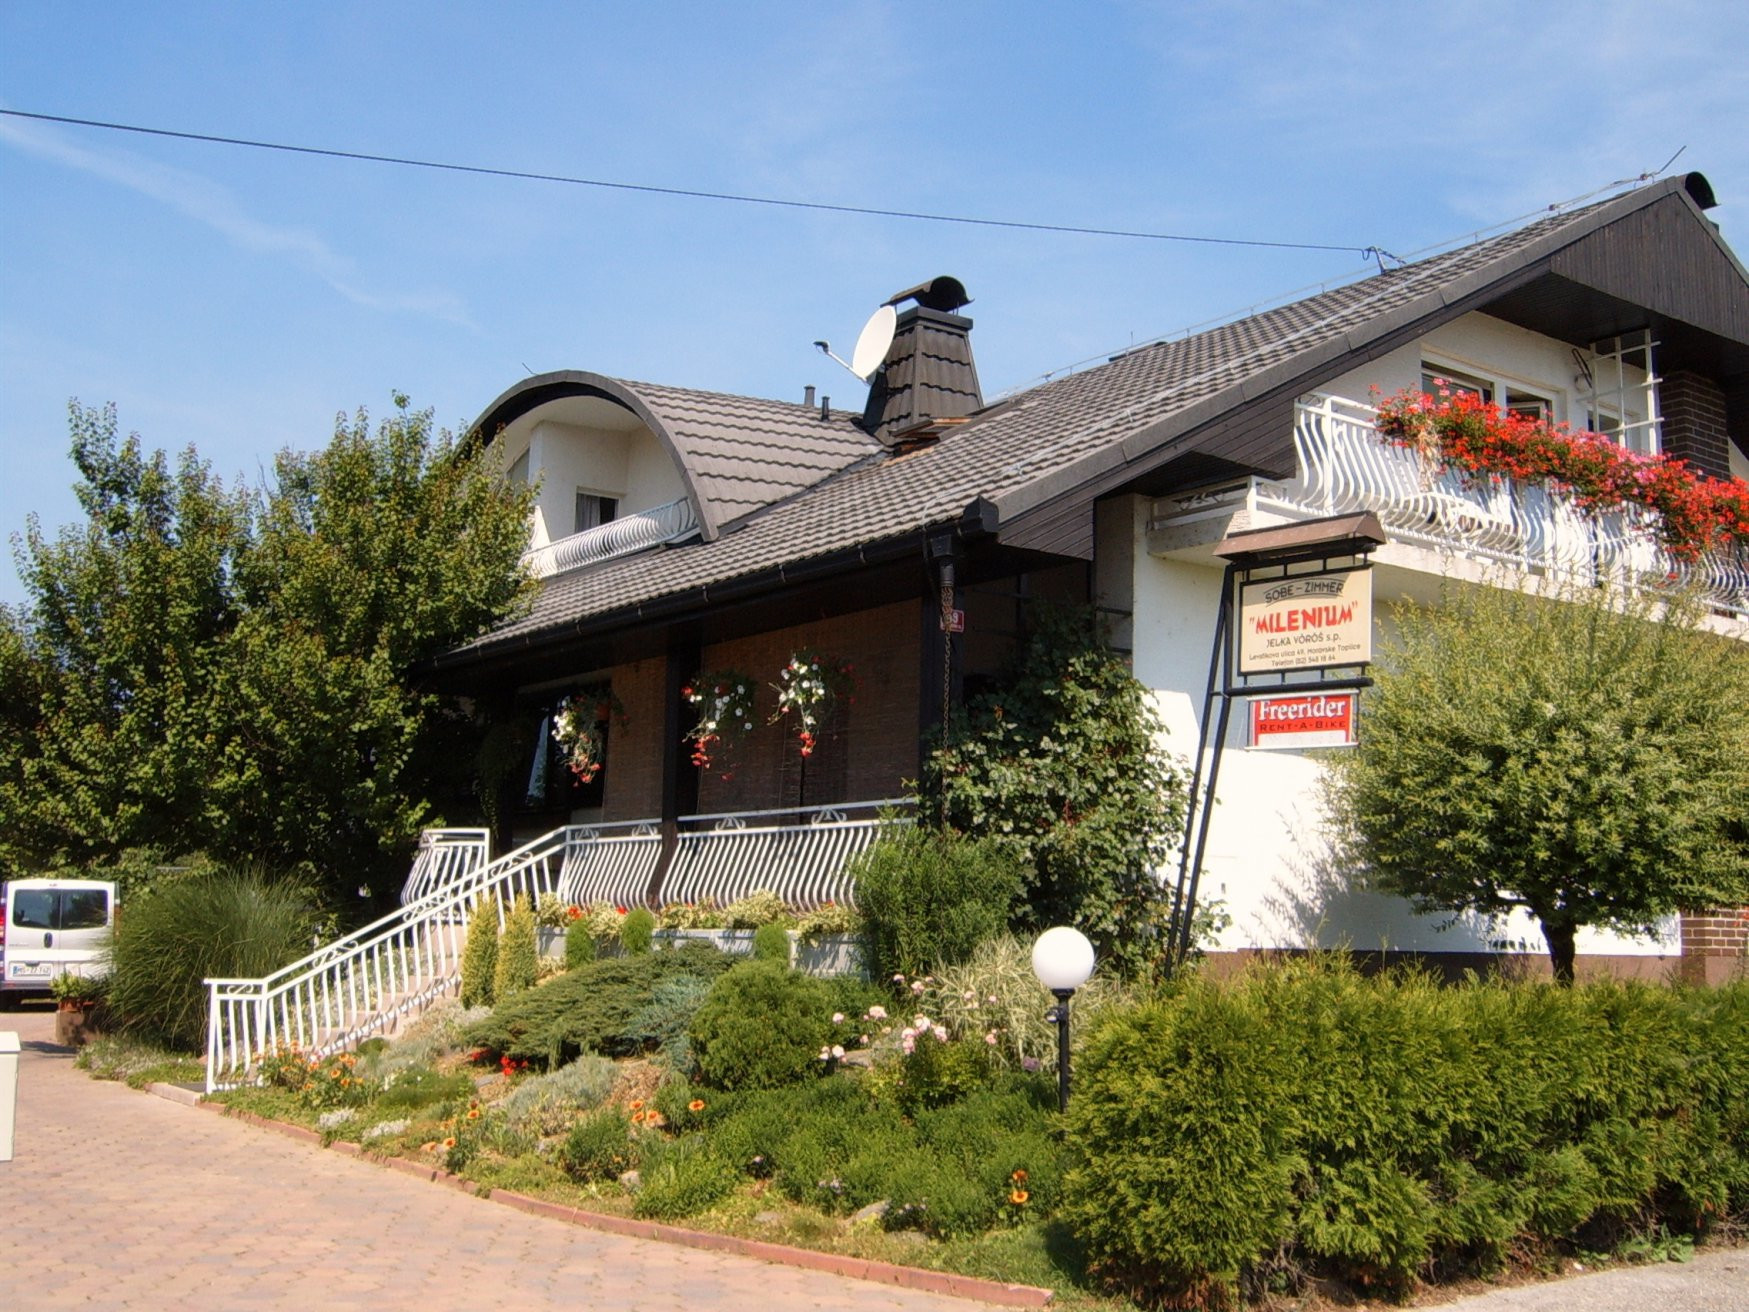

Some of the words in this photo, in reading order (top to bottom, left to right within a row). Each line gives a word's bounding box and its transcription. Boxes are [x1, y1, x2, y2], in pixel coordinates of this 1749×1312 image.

[1265, 585, 1294, 603] SOBE
[1304, 581, 1344, 594] ZIMMER
[1266, 637, 1291, 649] JELKA
[1326, 633, 1341, 643] s.p.
[1280, 649, 1295, 657] ulica
[1337, 643, 1361, 652] Toplice
[1259, 697, 1345, 720] Freerider
